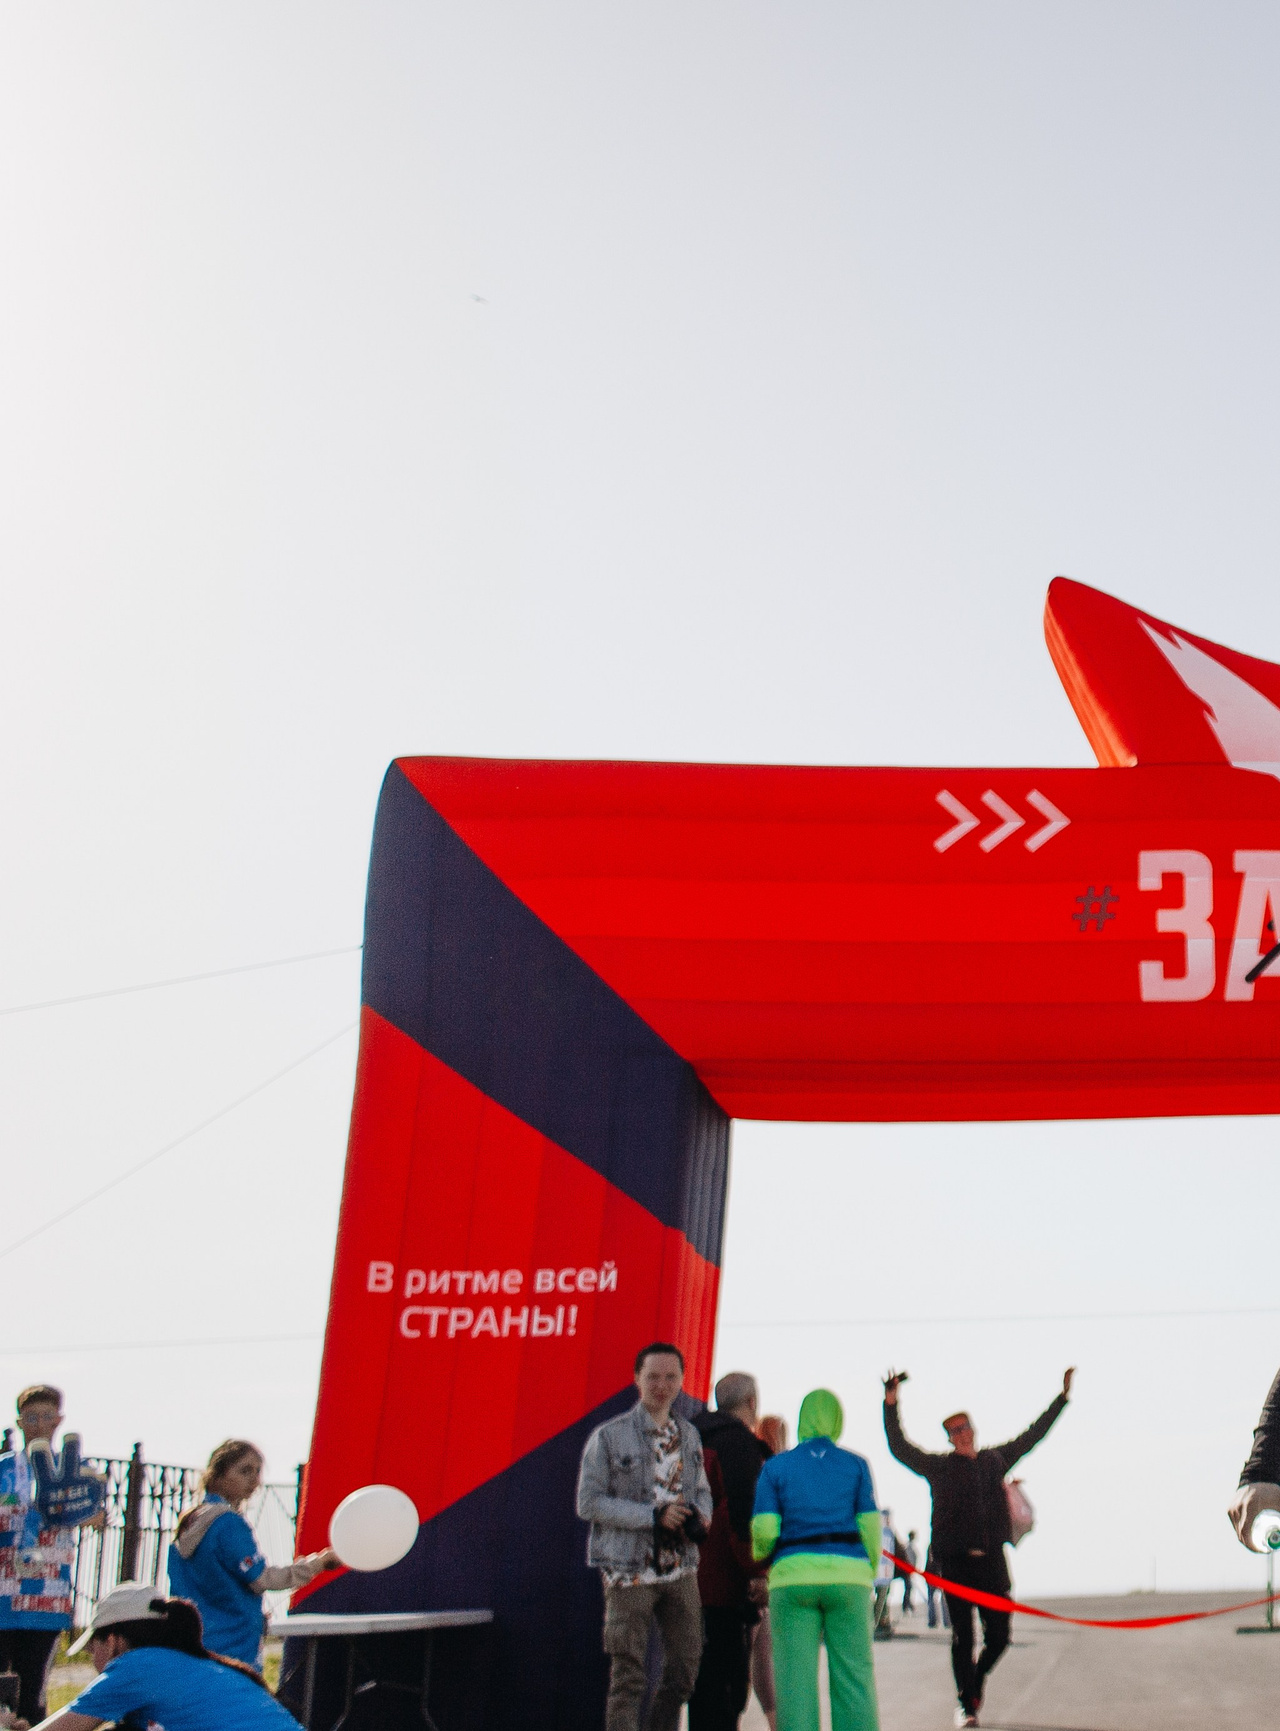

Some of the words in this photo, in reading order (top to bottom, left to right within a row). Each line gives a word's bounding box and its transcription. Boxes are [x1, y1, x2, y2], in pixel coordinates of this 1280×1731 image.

[367, 1260, 395, 1293] В
[404, 1268, 524, 1299] ритме
[534, 1259, 619, 1294] всей
[400, 1304, 579, 1339] СТРАНЫ!
